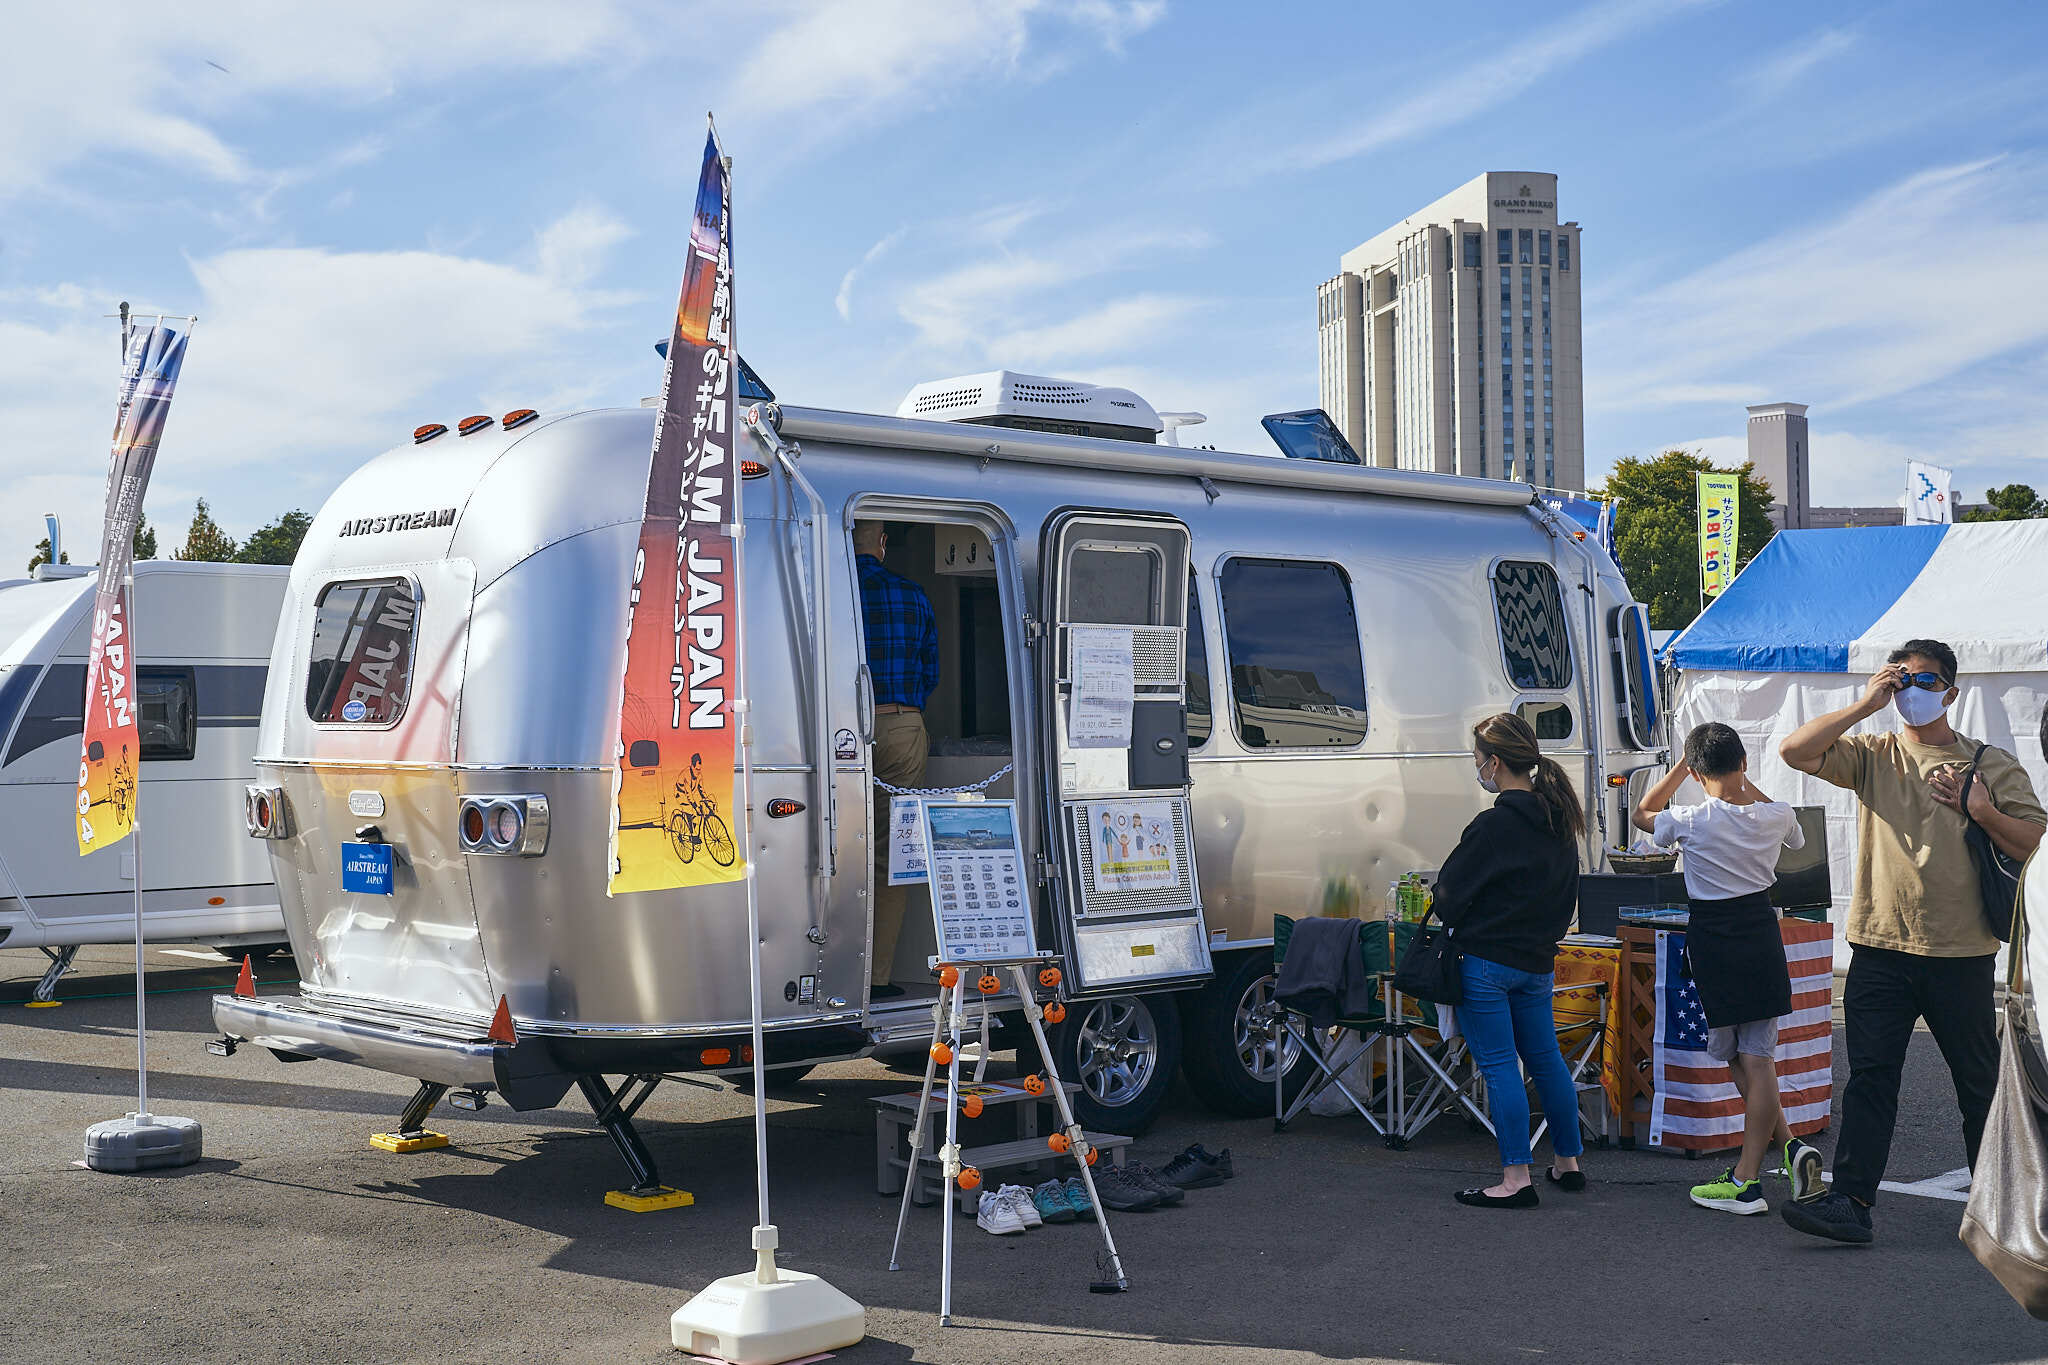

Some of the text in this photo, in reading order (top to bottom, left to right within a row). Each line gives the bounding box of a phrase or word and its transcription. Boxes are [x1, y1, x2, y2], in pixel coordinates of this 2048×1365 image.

[1494, 199, 1527, 209] GRAND
[338, 508, 457, 538] AIRSTREAM
[687, 539, 724, 729] JAPAN
[345, 861, 389, 875] AIRSTREAM
[366, 875, 384, 885] JAPAN
